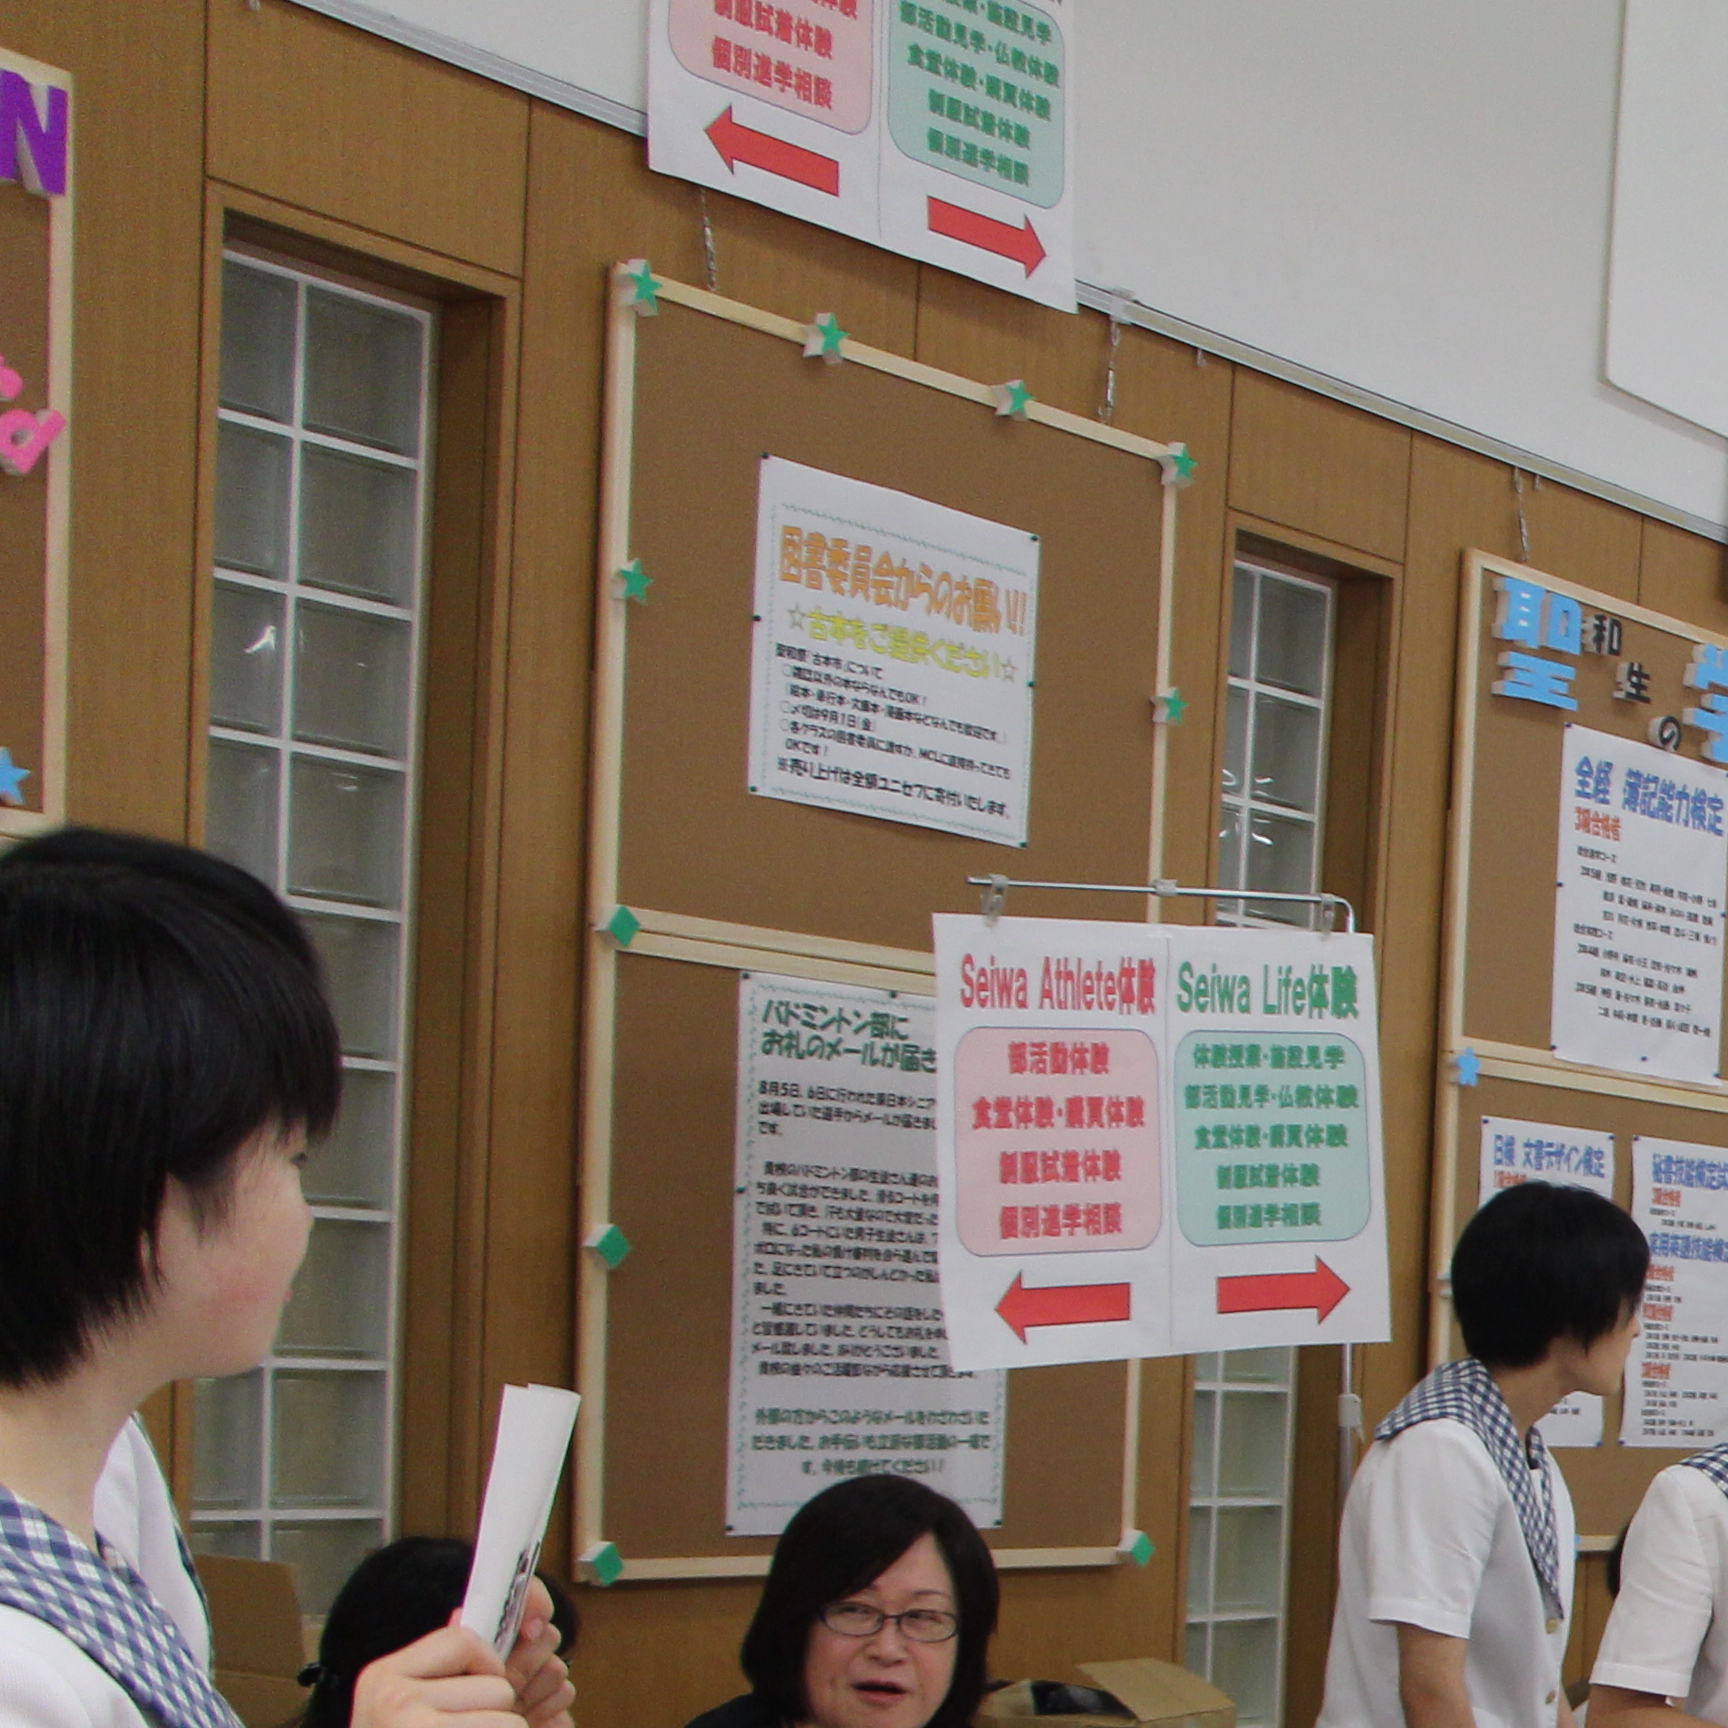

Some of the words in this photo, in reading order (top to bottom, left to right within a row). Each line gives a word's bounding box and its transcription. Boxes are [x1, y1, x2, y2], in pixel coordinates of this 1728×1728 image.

[712, 35, 832, 110] 個別進学相談
[960, 953, 1028, 1010] Seiwa
[1038, 955, 1156, 1015] Athlete体験
[1177, 961, 1251, 1014] Seiwa
[1262, 963, 1359, 1019] Life体験
[762, 999, 909, 1041] バドミントン部に
[1008, 1041, 1109, 1075] 部活動体験
[1193, 1043, 1346, 1071] 体験授業・施設見学
[972, 1095, 1145, 1130] 食堂体験・購買体験
[999, 1150, 1121, 1185] 制服試着体験
[1217, 1163, 1320, 1190] 制服試着体験
[1000, 1202, 1122, 1240] 個別進学相談
[1217, 1202, 1320, 1229] 個別進学相談
